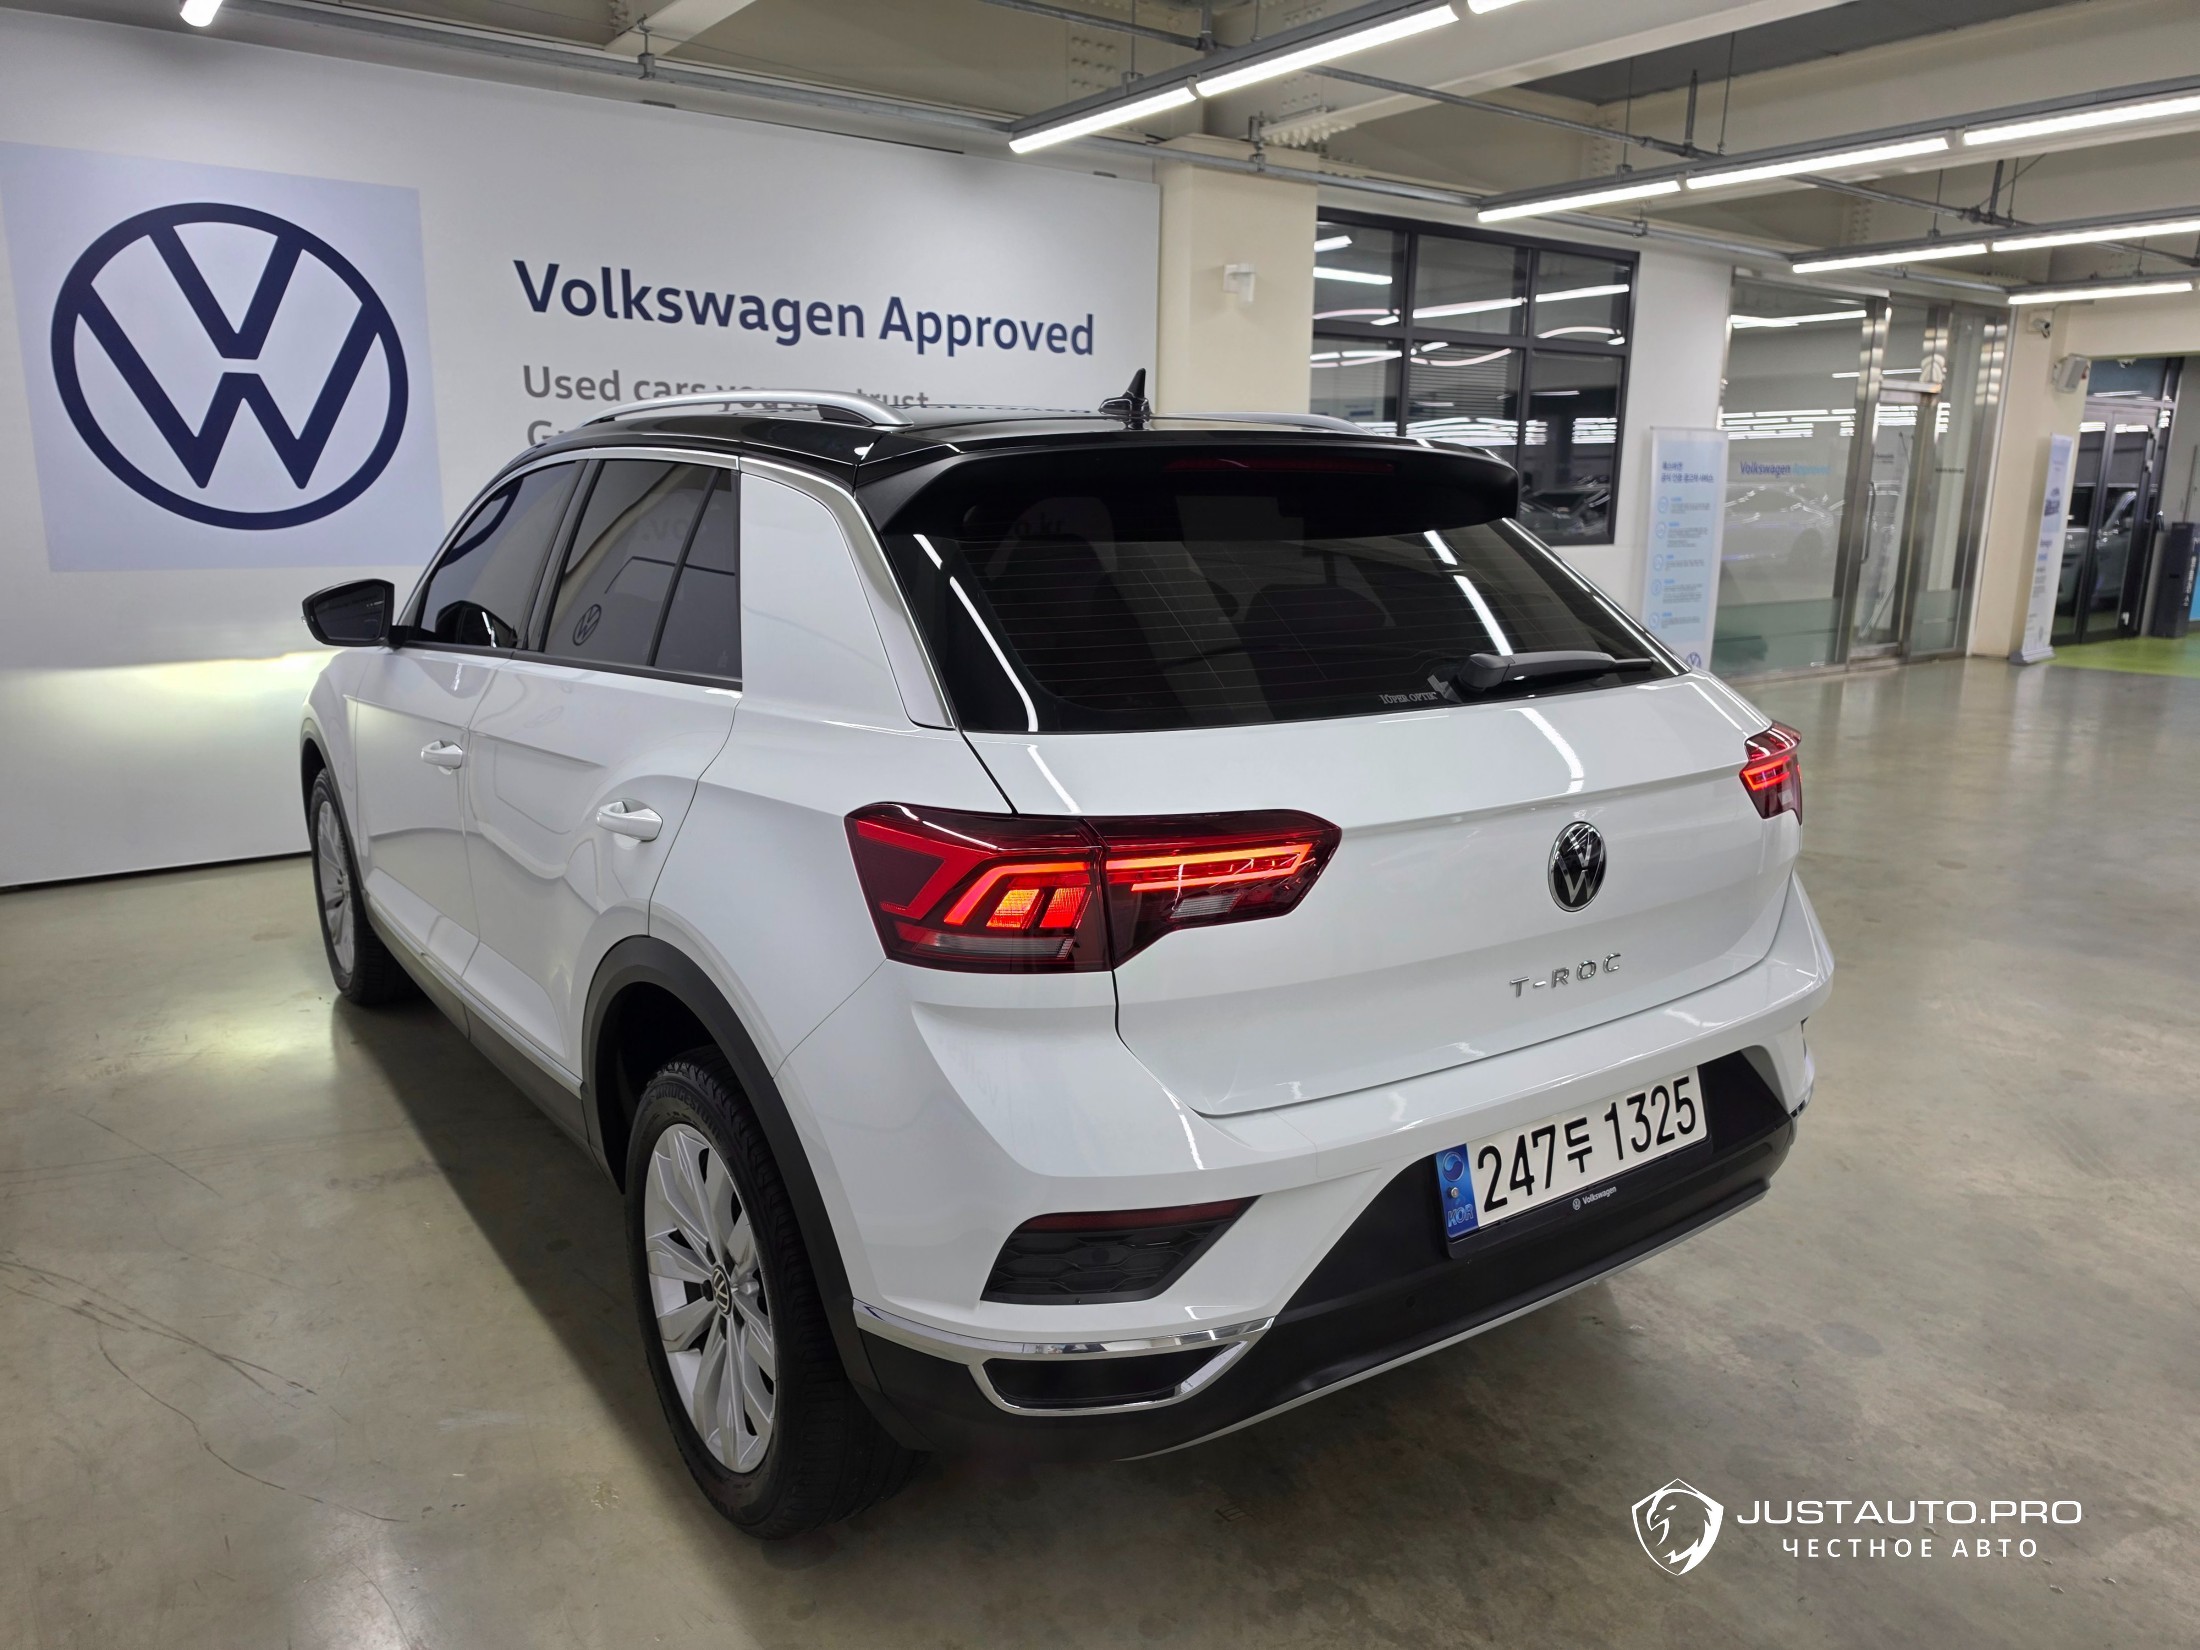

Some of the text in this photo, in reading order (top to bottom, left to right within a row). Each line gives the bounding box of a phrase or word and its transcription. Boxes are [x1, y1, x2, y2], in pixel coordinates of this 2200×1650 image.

[513, 259, 1094, 357] Volkswagen Approved
[51, 202, 409, 531] VW
[523, 364, 620, 401] Used
[1740, 461, 1791, 479] Volkswagen
[1548, 821, 1607, 912] VW
[1509, 953, 1621, 998] T-ROC
[1477, 1076, 1696, 1213] 247두 1325
[1447, 1203, 1474, 1228] KOR
[1582, 1186, 1617, 1205] Volkswagen
